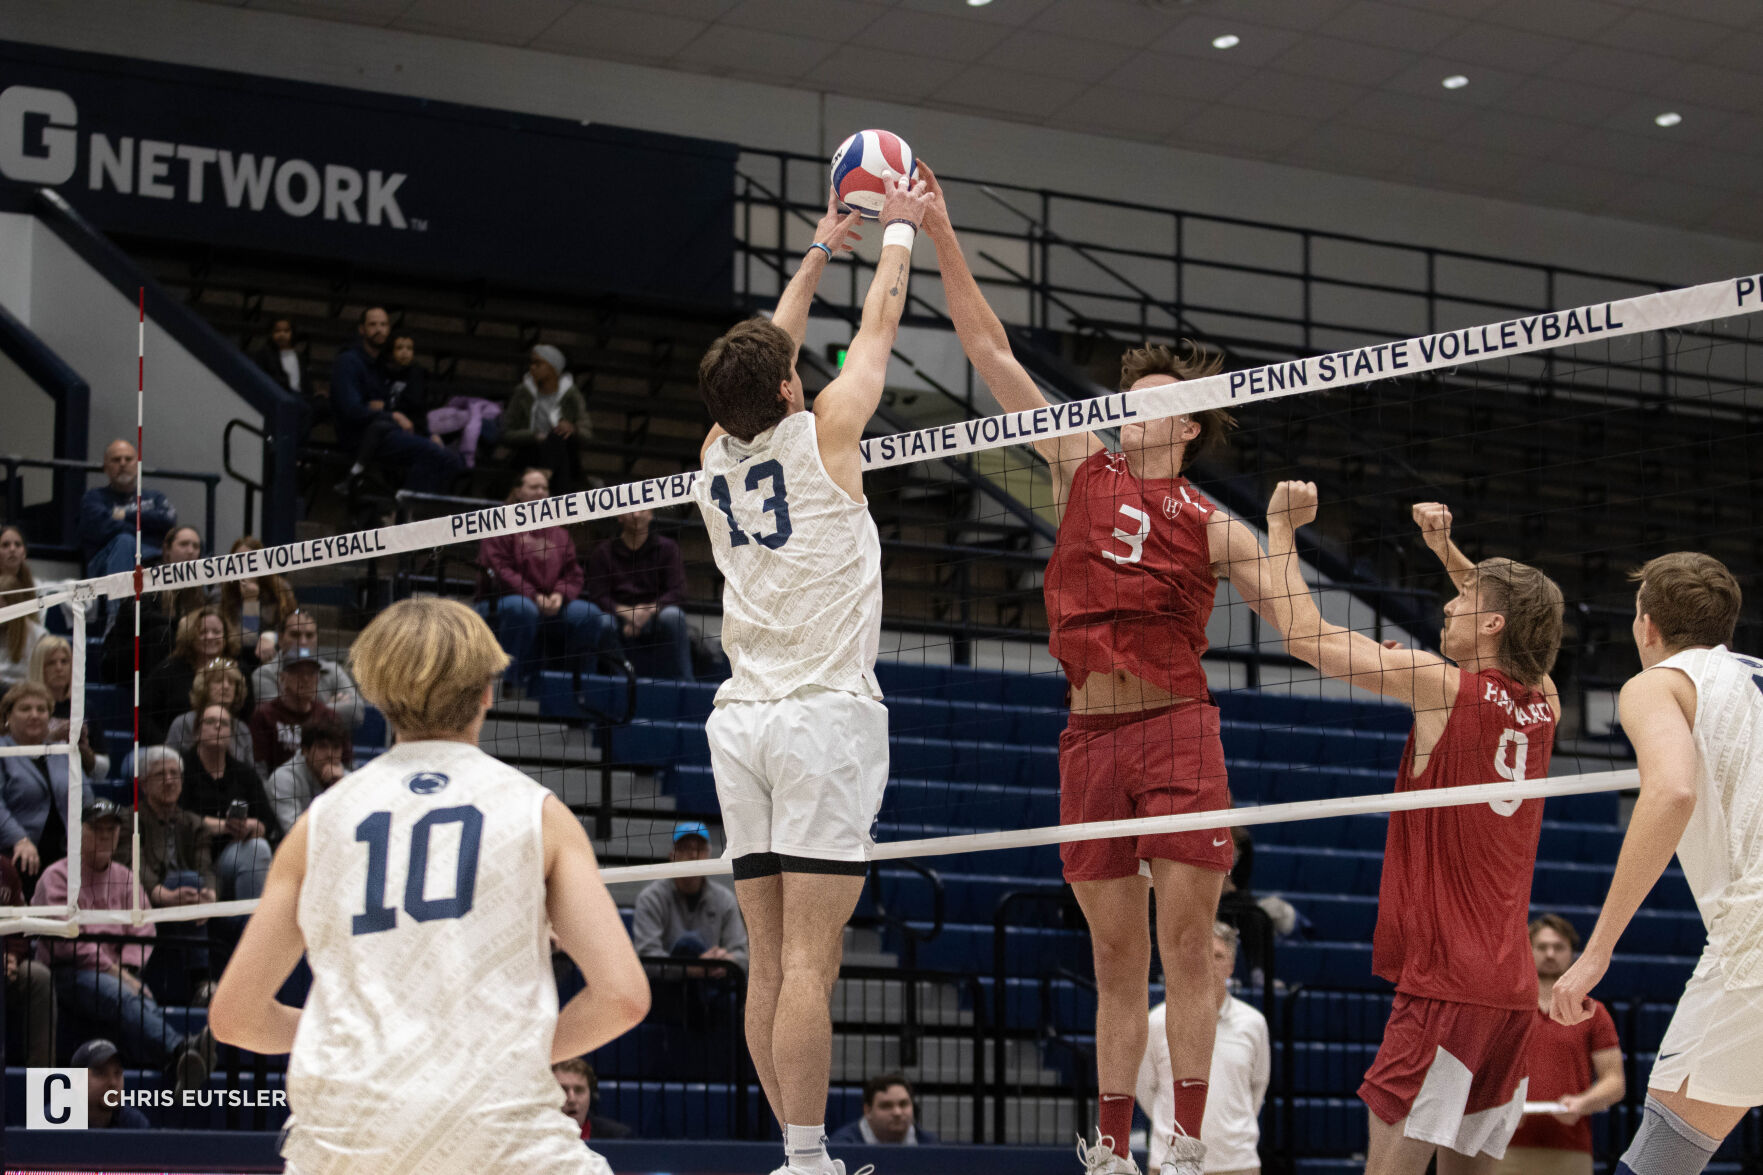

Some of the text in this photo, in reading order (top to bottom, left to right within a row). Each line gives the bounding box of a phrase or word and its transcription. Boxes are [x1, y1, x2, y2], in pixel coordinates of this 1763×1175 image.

[89, 133, 408, 229] NETWORK
[1230, 304, 1623, 398] PENN STATE VOLLEYBALL
[881, 425, 957, 460] STATE
[965, 393, 1137, 442] VOLLEYBALL
[451, 475, 696, 537] PENN STATE VOLLEYBA
[710, 459, 792, 550] 13
[1102, 504, 1150, 565] 3
[151, 531, 386, 586] PENN STATE VOLLEYBALL
[352, 804, 484, 936] 10
